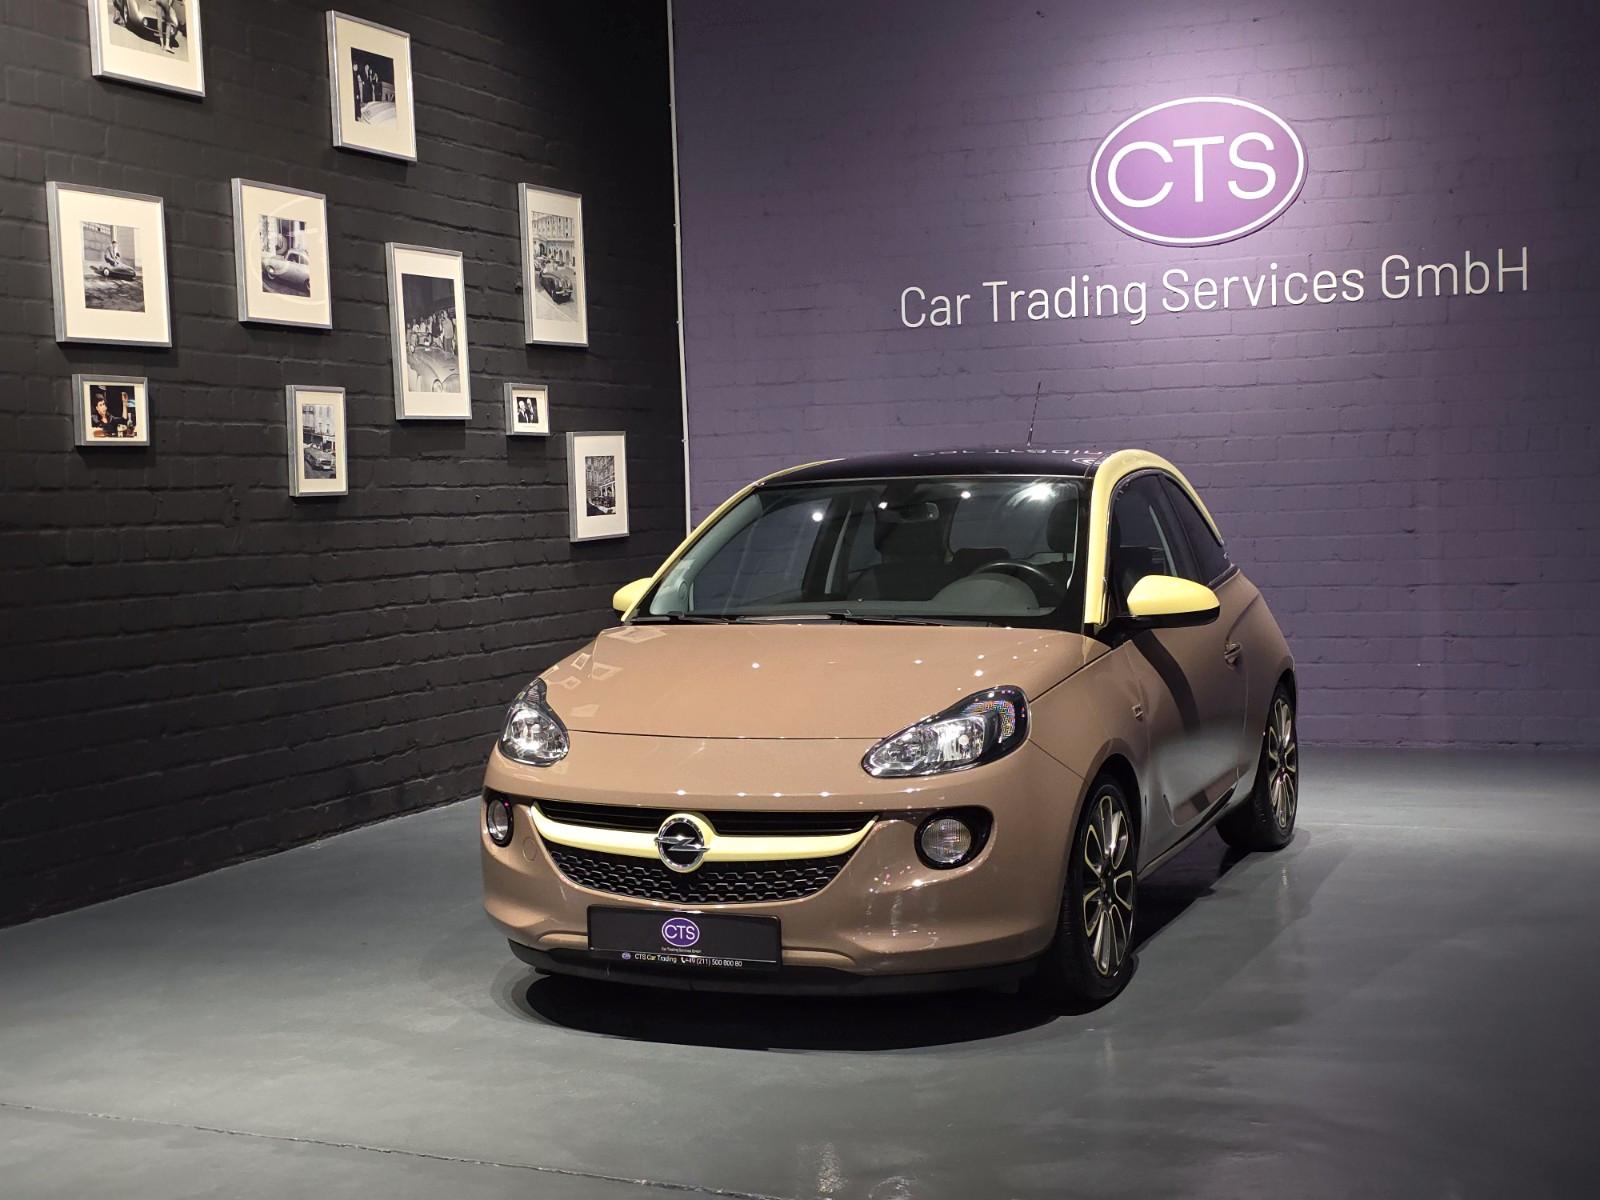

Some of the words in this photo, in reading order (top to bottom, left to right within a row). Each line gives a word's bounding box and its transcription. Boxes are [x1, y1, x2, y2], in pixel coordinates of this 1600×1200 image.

[1107, 131, 1277, 208] CTS
[900, 287, 970, 328] Car
[982, 274, 1148, 325] Trading
[1161, 262, 1365, 312] Services
[1381, 246, 1530, 300] GmbH
[664, 924, 696, 940] CTS
[634, 953, 646, 961] CTS
[657, 954, 677, 964] Trading
[712, 958, 723, 966] 500
